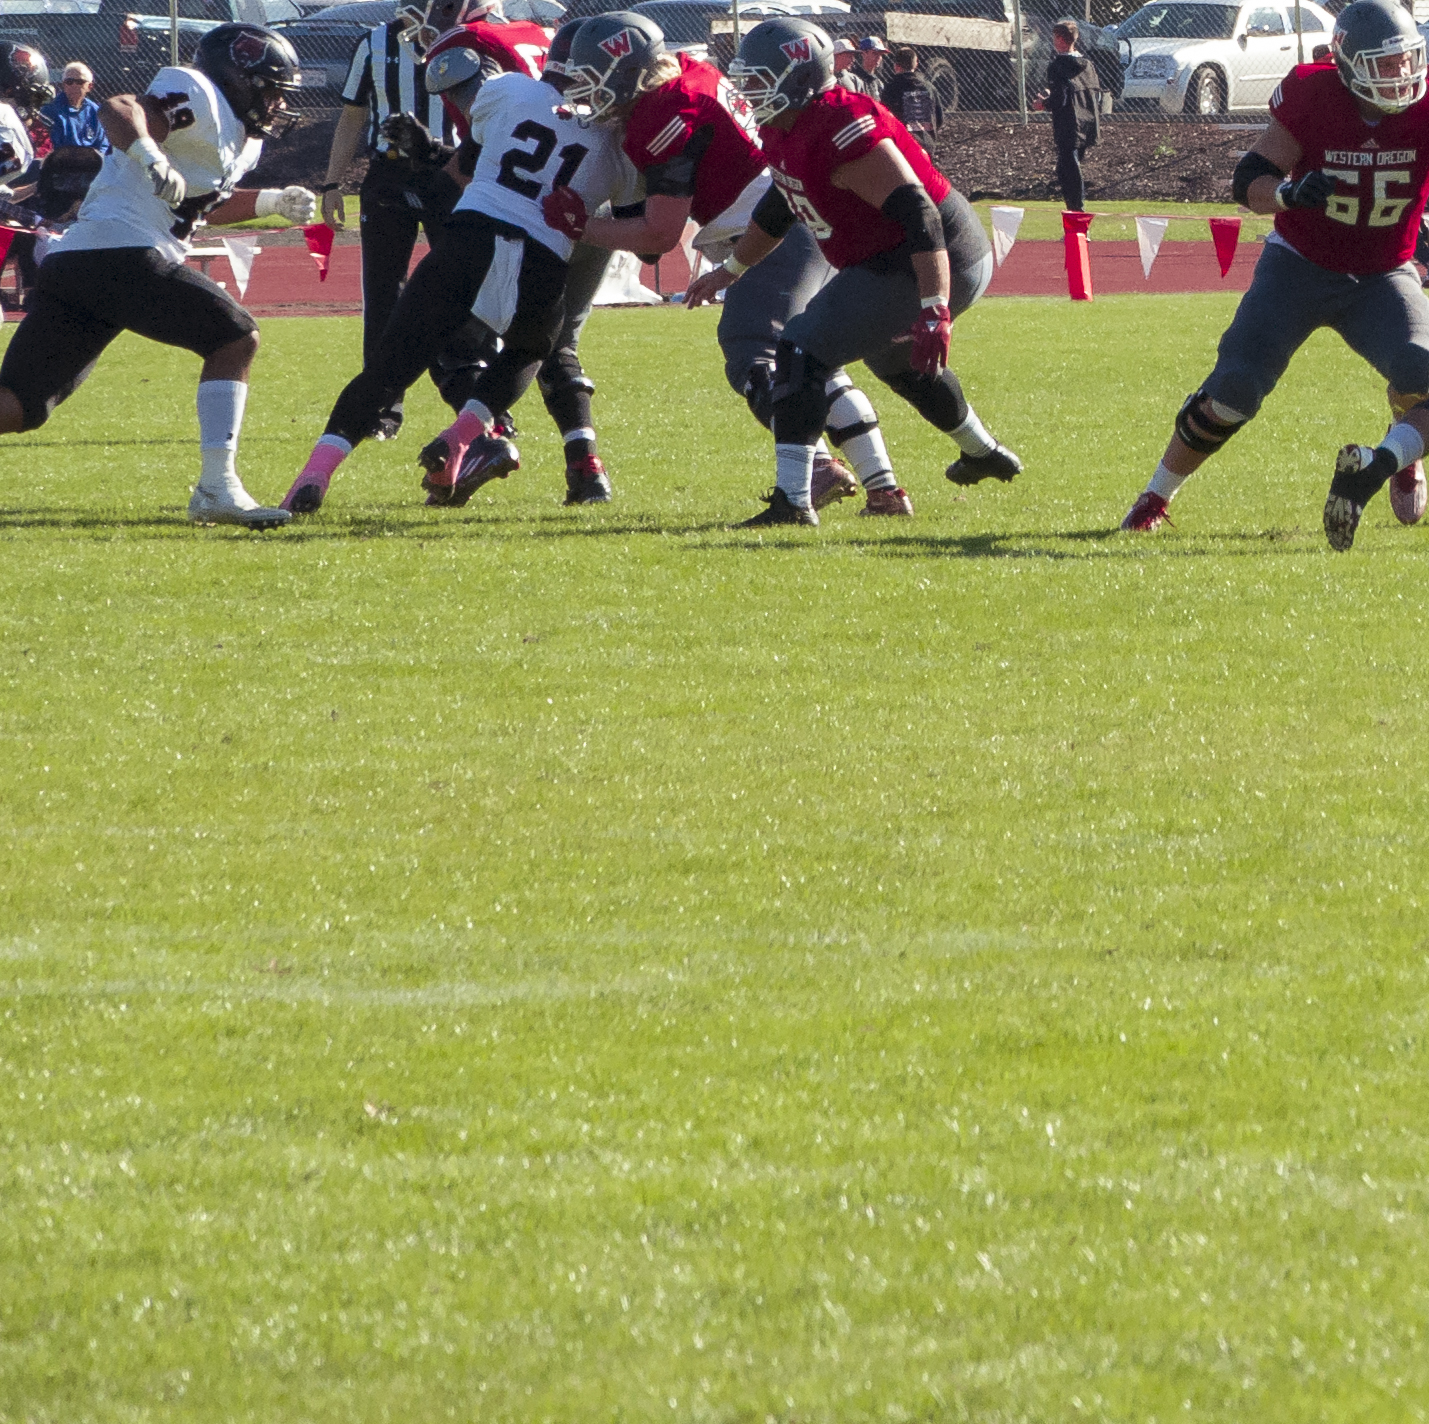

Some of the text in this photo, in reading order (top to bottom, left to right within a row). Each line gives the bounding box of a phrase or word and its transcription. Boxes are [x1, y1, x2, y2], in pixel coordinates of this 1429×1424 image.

[597, 28, 633, 59] W
[780, 37, 812, 63] W
[496, 119, 589, 201] 21
[1324, 149, 1417, 165] WESTERN OREGON
